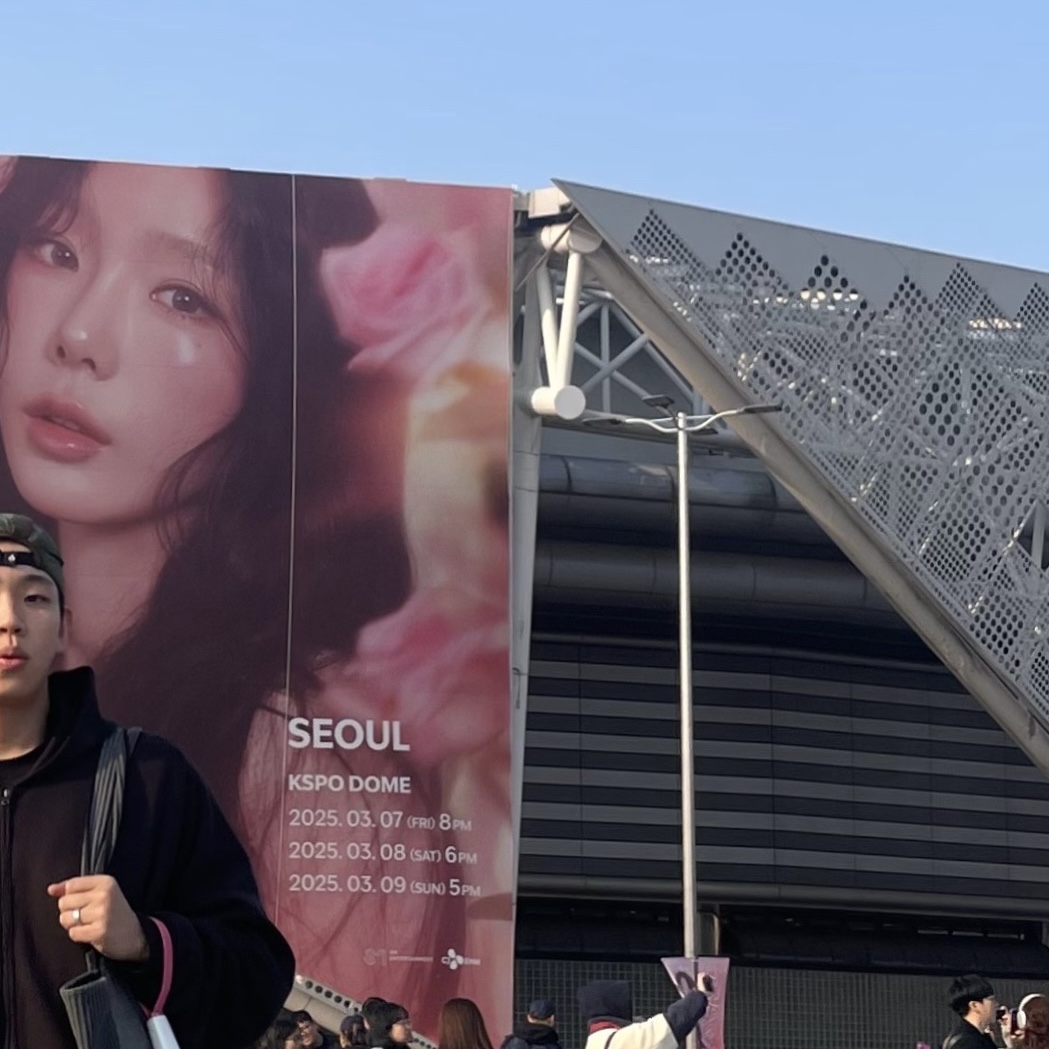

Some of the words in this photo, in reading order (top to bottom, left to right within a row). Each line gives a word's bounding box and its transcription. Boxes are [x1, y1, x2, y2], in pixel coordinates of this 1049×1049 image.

[288, 717, 411, 751] SEOUL
[288, 774, 345, 792] KSPO
[348, 775, 412, 794] DOME
[380, 811, 404, 829] 07
[406, 816, 435, 830] (FRI)
[380, 843, 406, 861] 08
[409, 849, 442, 863] (SAT)
[380, 876, 406, 894] 09
[410, 880, 446, 896] (SUN)
